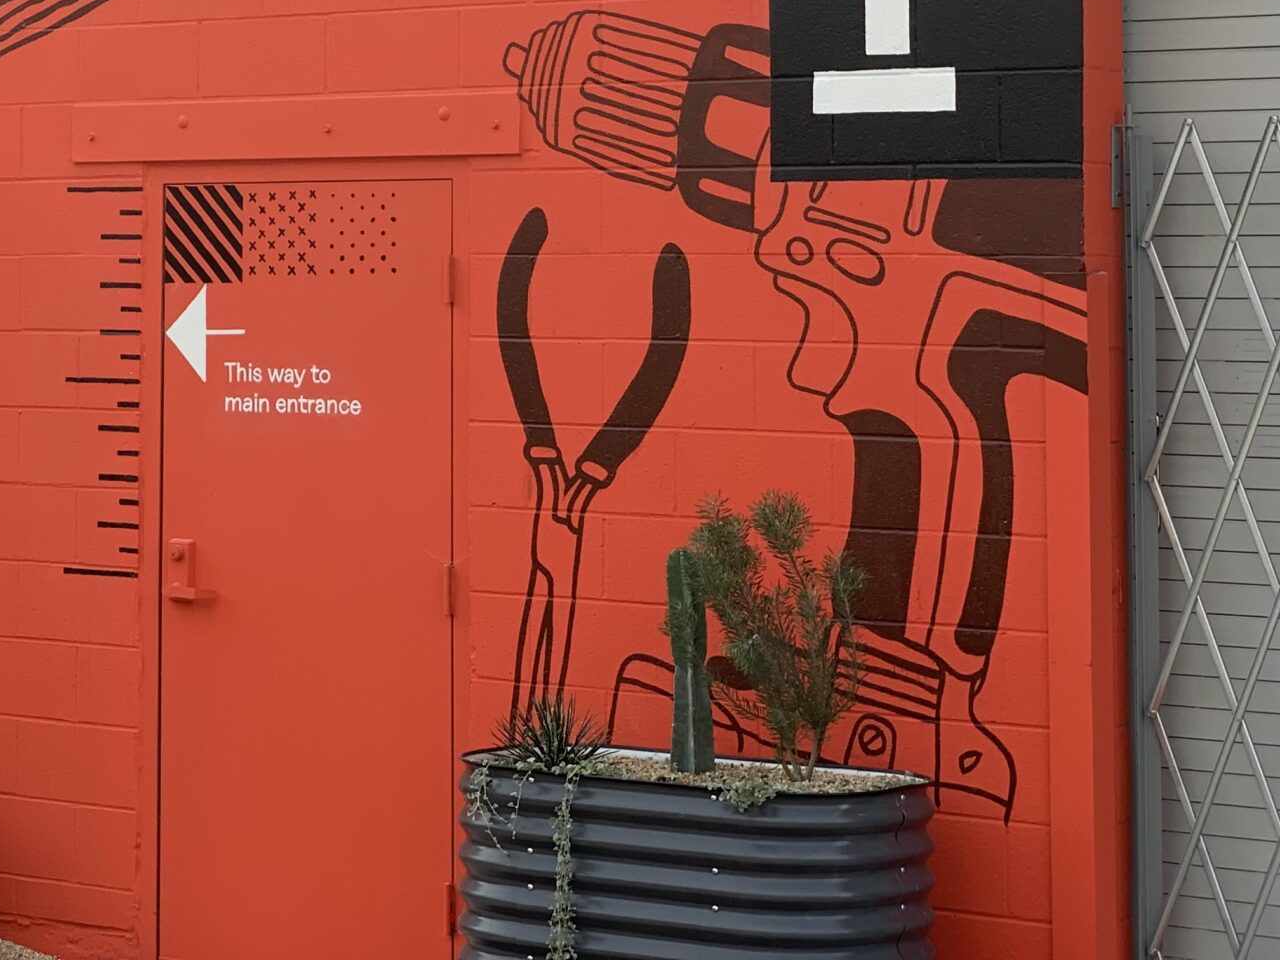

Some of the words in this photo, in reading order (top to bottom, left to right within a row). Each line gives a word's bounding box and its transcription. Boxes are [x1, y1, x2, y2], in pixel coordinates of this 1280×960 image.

[223, 361, 263, 383] This
[267, 366, 307, 388] way
[310, 364, 331, 384] to
[223, 393, 270, 413] main
[275, 394, 362, 416] entrance
